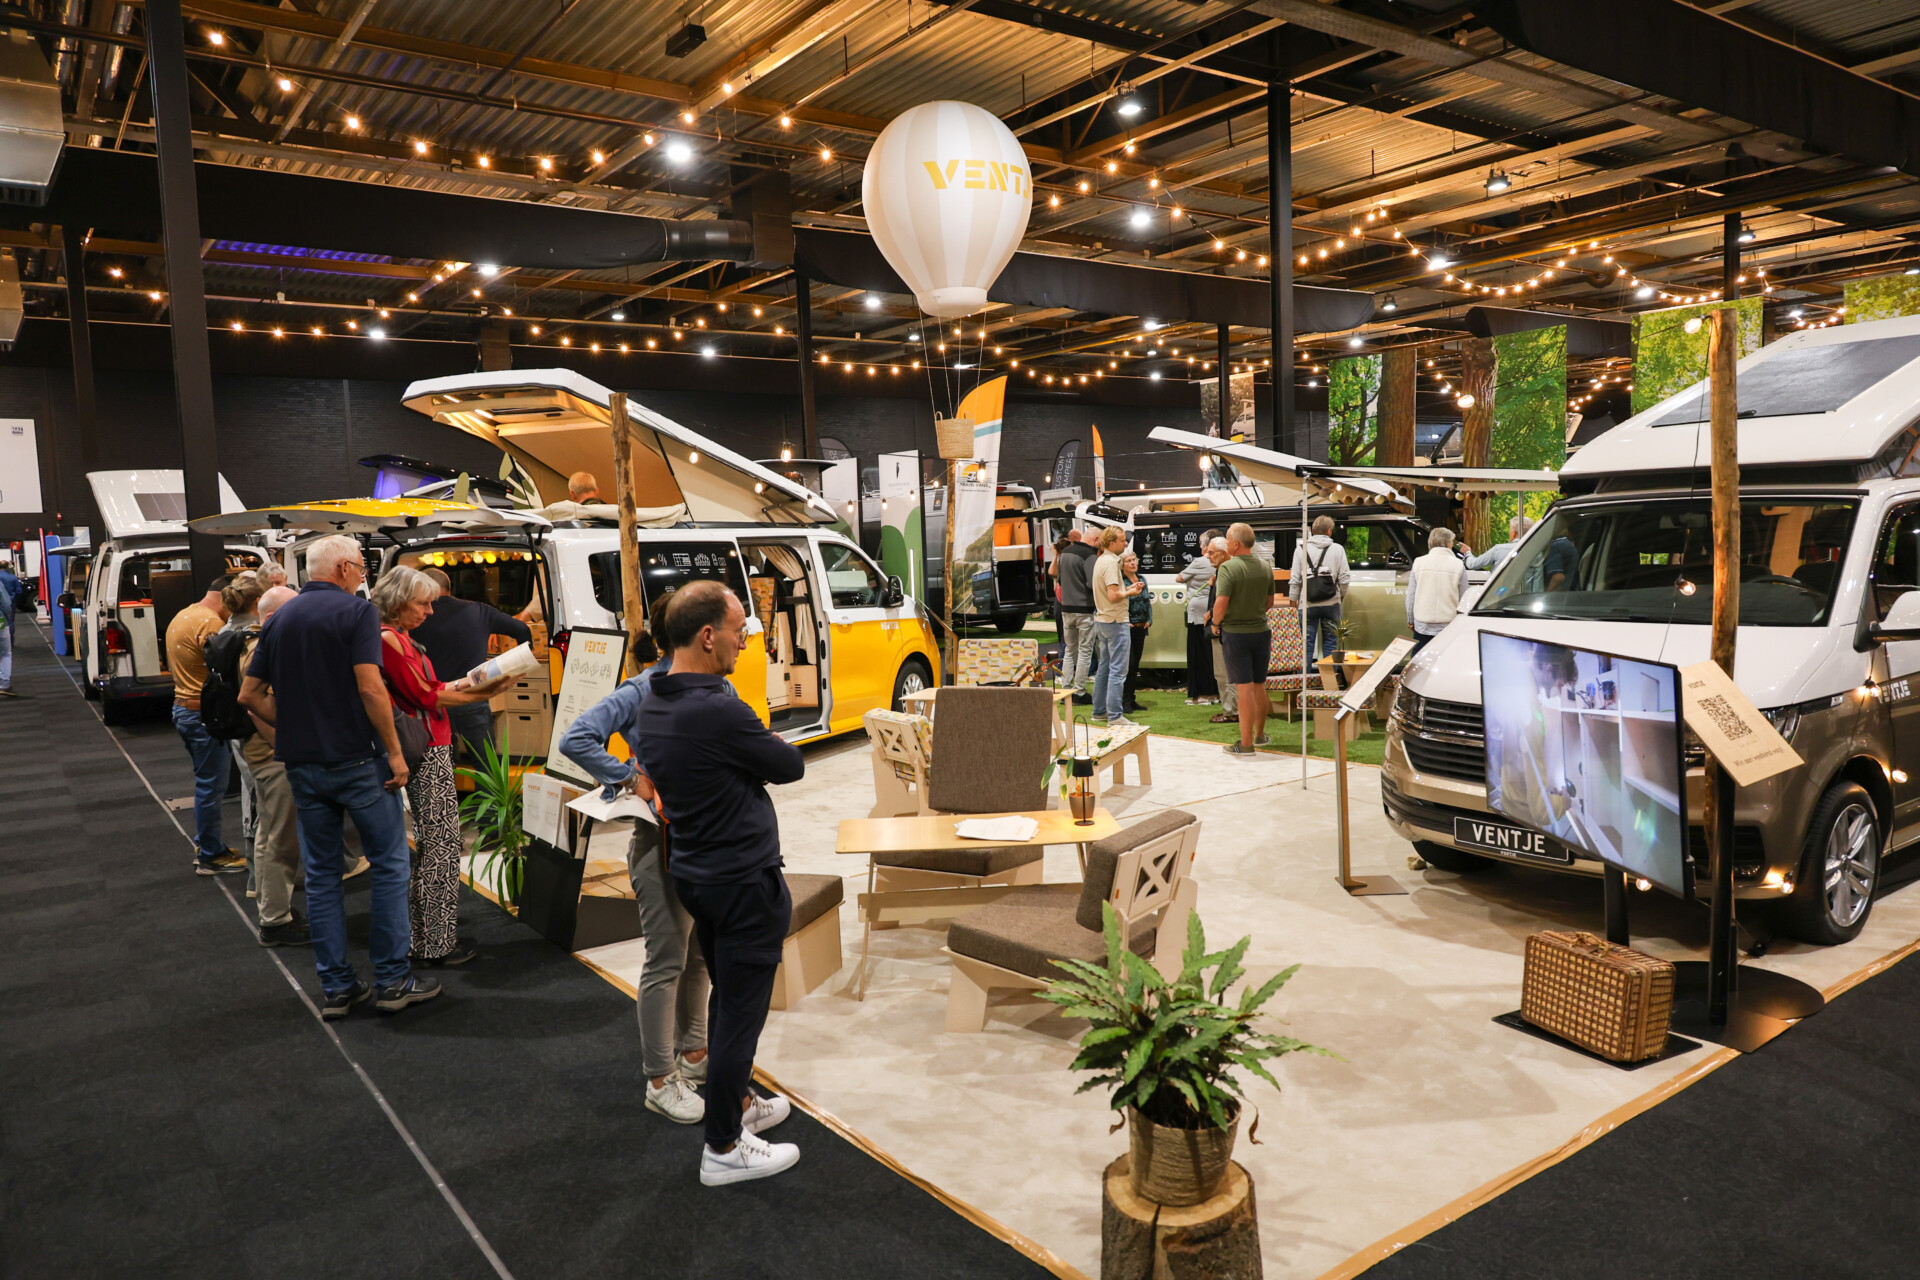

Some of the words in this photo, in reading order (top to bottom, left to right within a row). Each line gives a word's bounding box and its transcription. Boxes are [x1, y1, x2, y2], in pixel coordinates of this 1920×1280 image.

[1060, 452, 1074, 489] AMPERS
[585, 640, 607, 654] VENTJE
[1472, 823, 1546, 854] VENTJE
